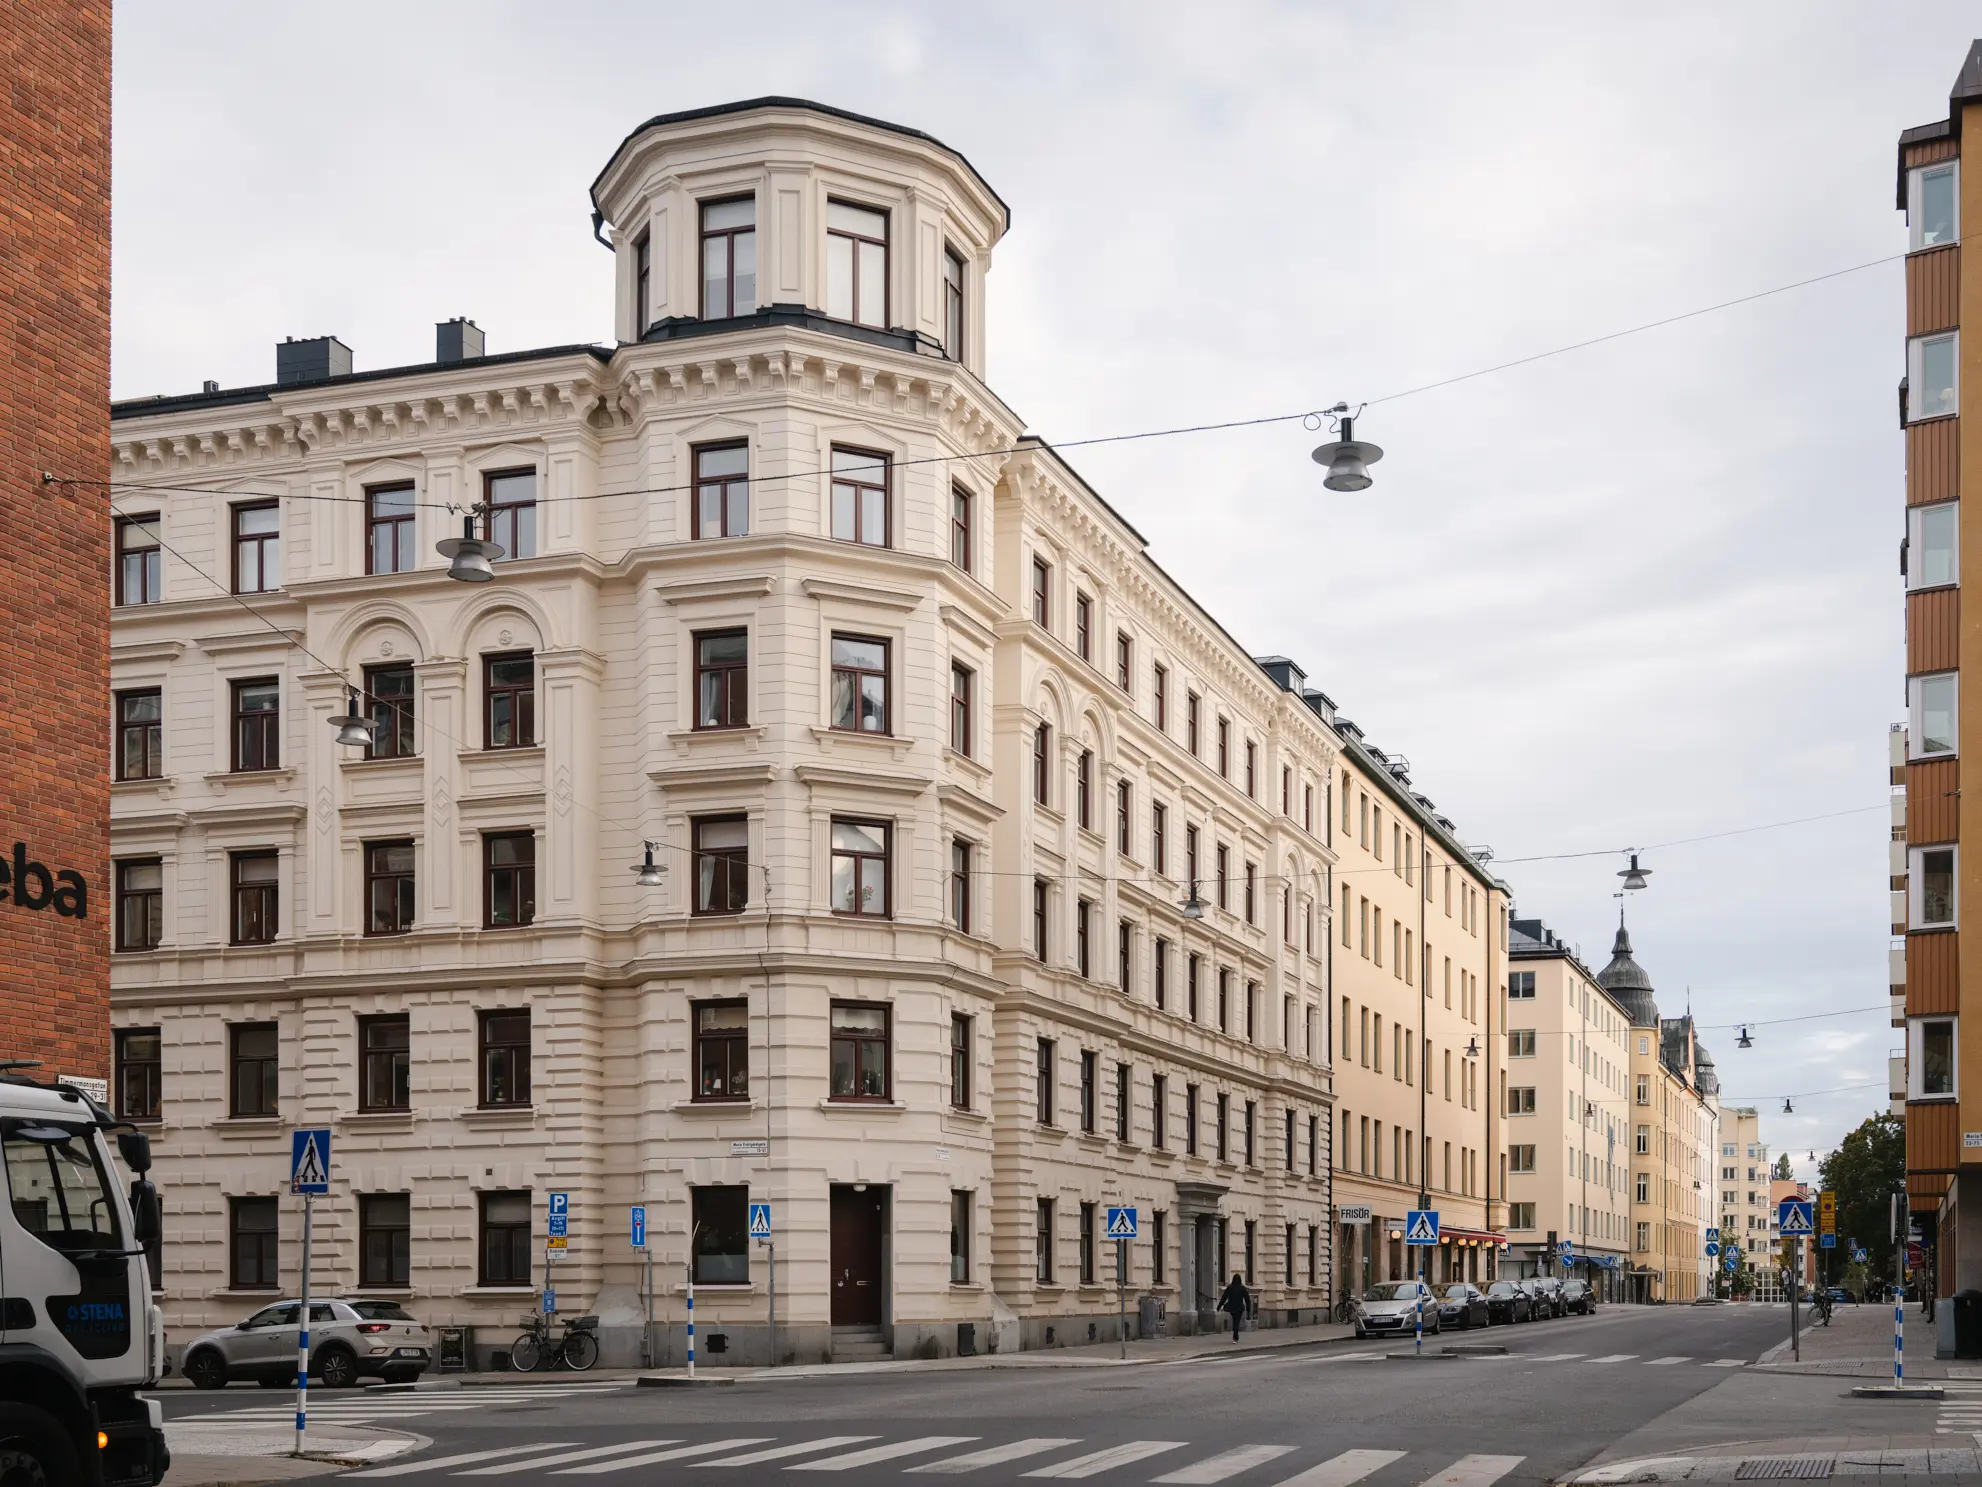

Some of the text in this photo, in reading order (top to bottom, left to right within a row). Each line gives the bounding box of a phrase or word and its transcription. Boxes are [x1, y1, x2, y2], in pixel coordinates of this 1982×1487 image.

[60, 1077, 106, 1089] Timmermansgatan
[554, 1195, 565, 1212] P
[1341, 1208, 1370, 1219] FRISÖR
[81, 1304, 123, 1320] STENA
